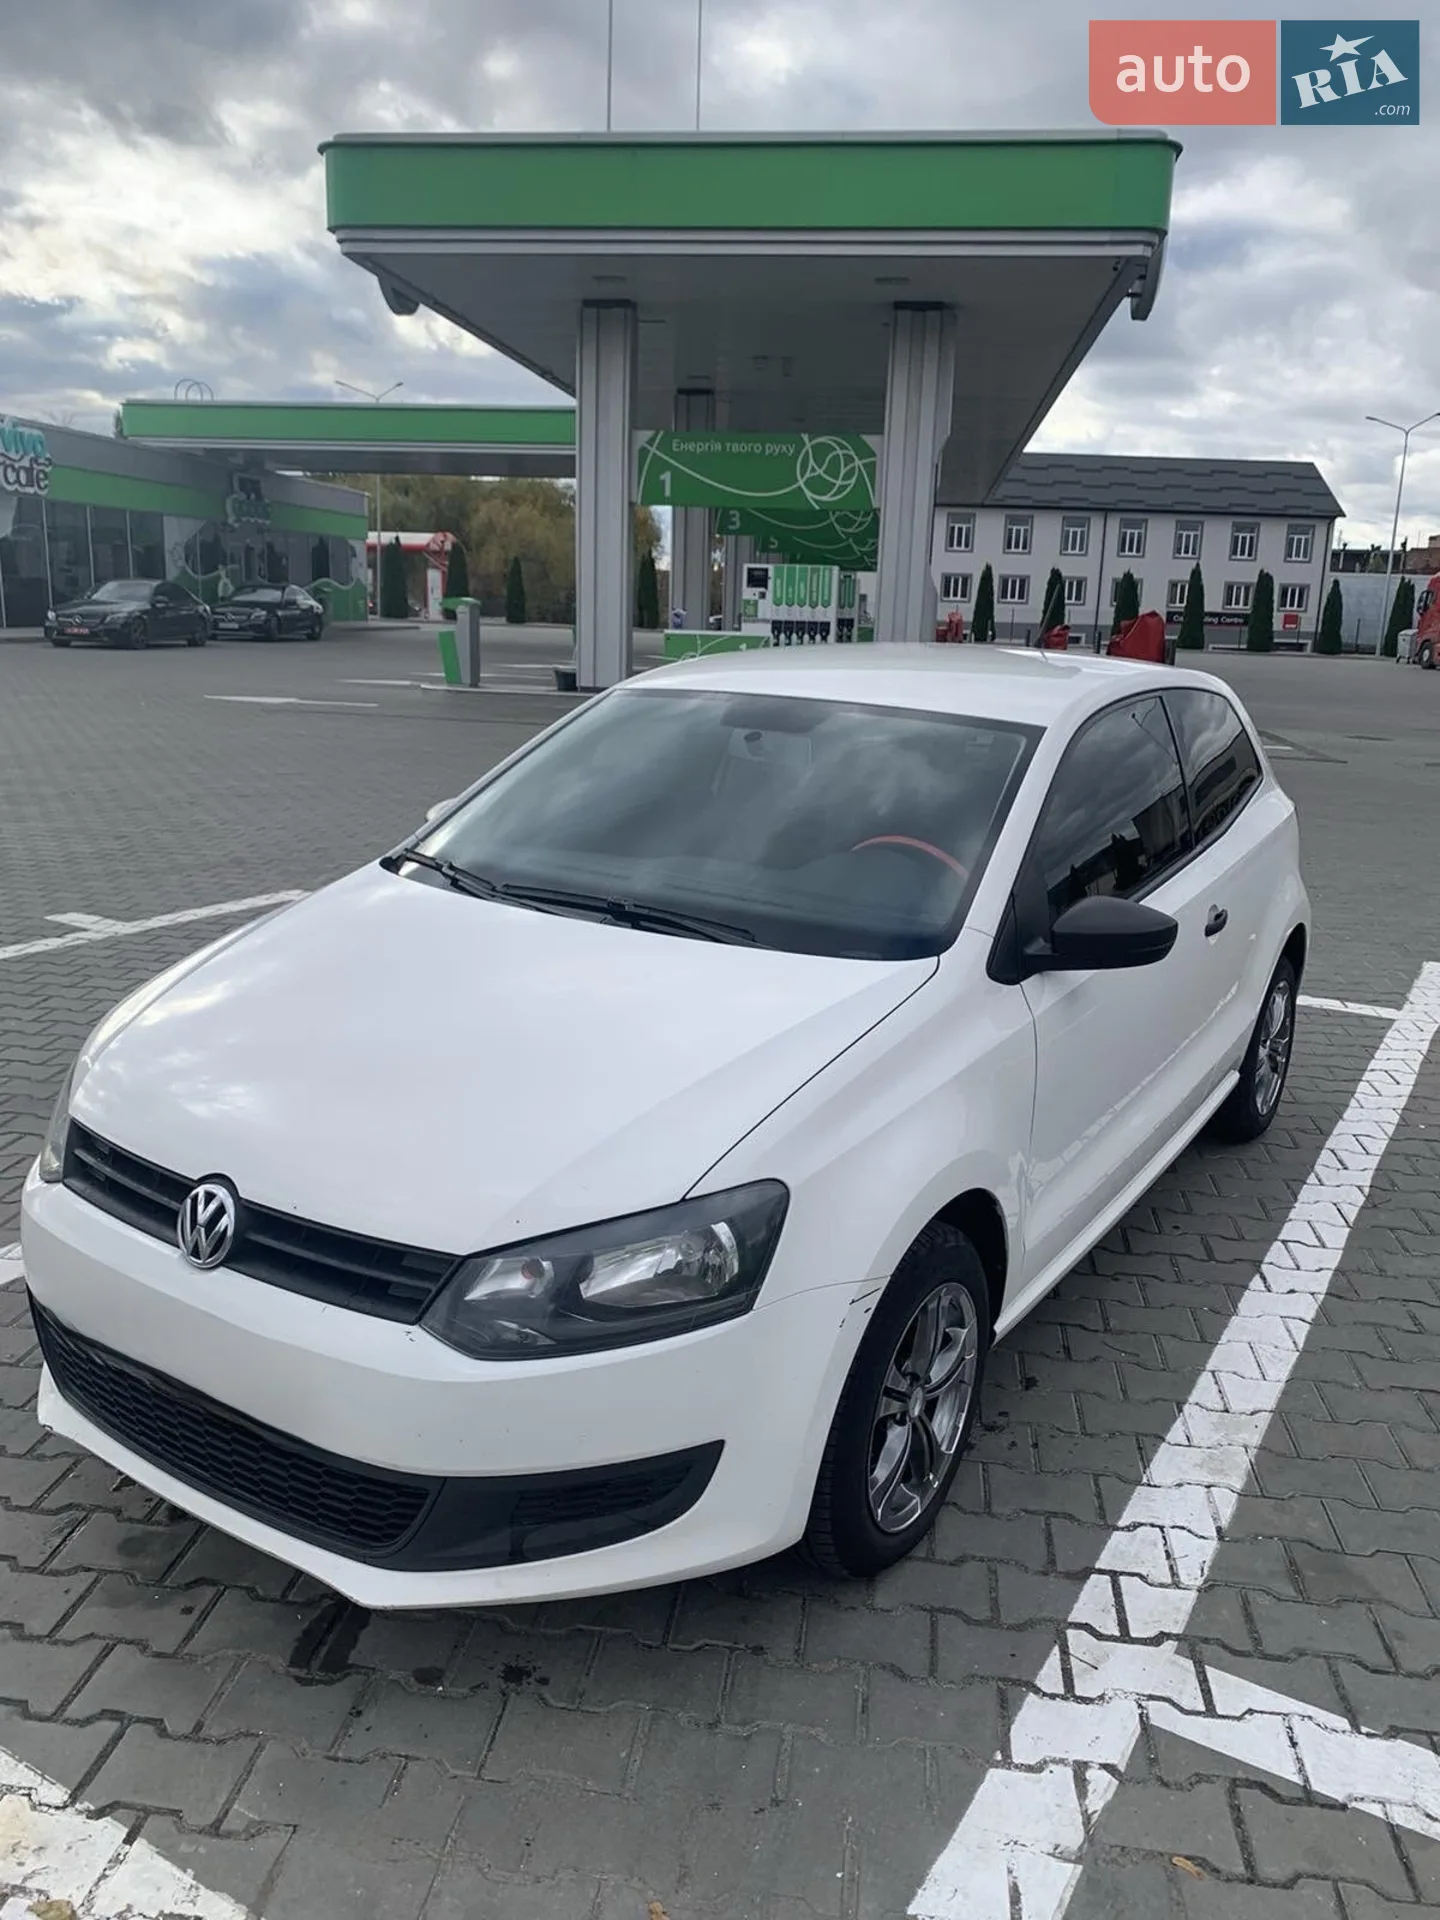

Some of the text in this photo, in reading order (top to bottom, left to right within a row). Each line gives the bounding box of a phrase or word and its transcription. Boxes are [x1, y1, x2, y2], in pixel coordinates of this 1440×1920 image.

[672, 439, 795, 457] Енергія твого руху
[659, 470, 672, 497] 1
[728, 510, 741, 530] 3
